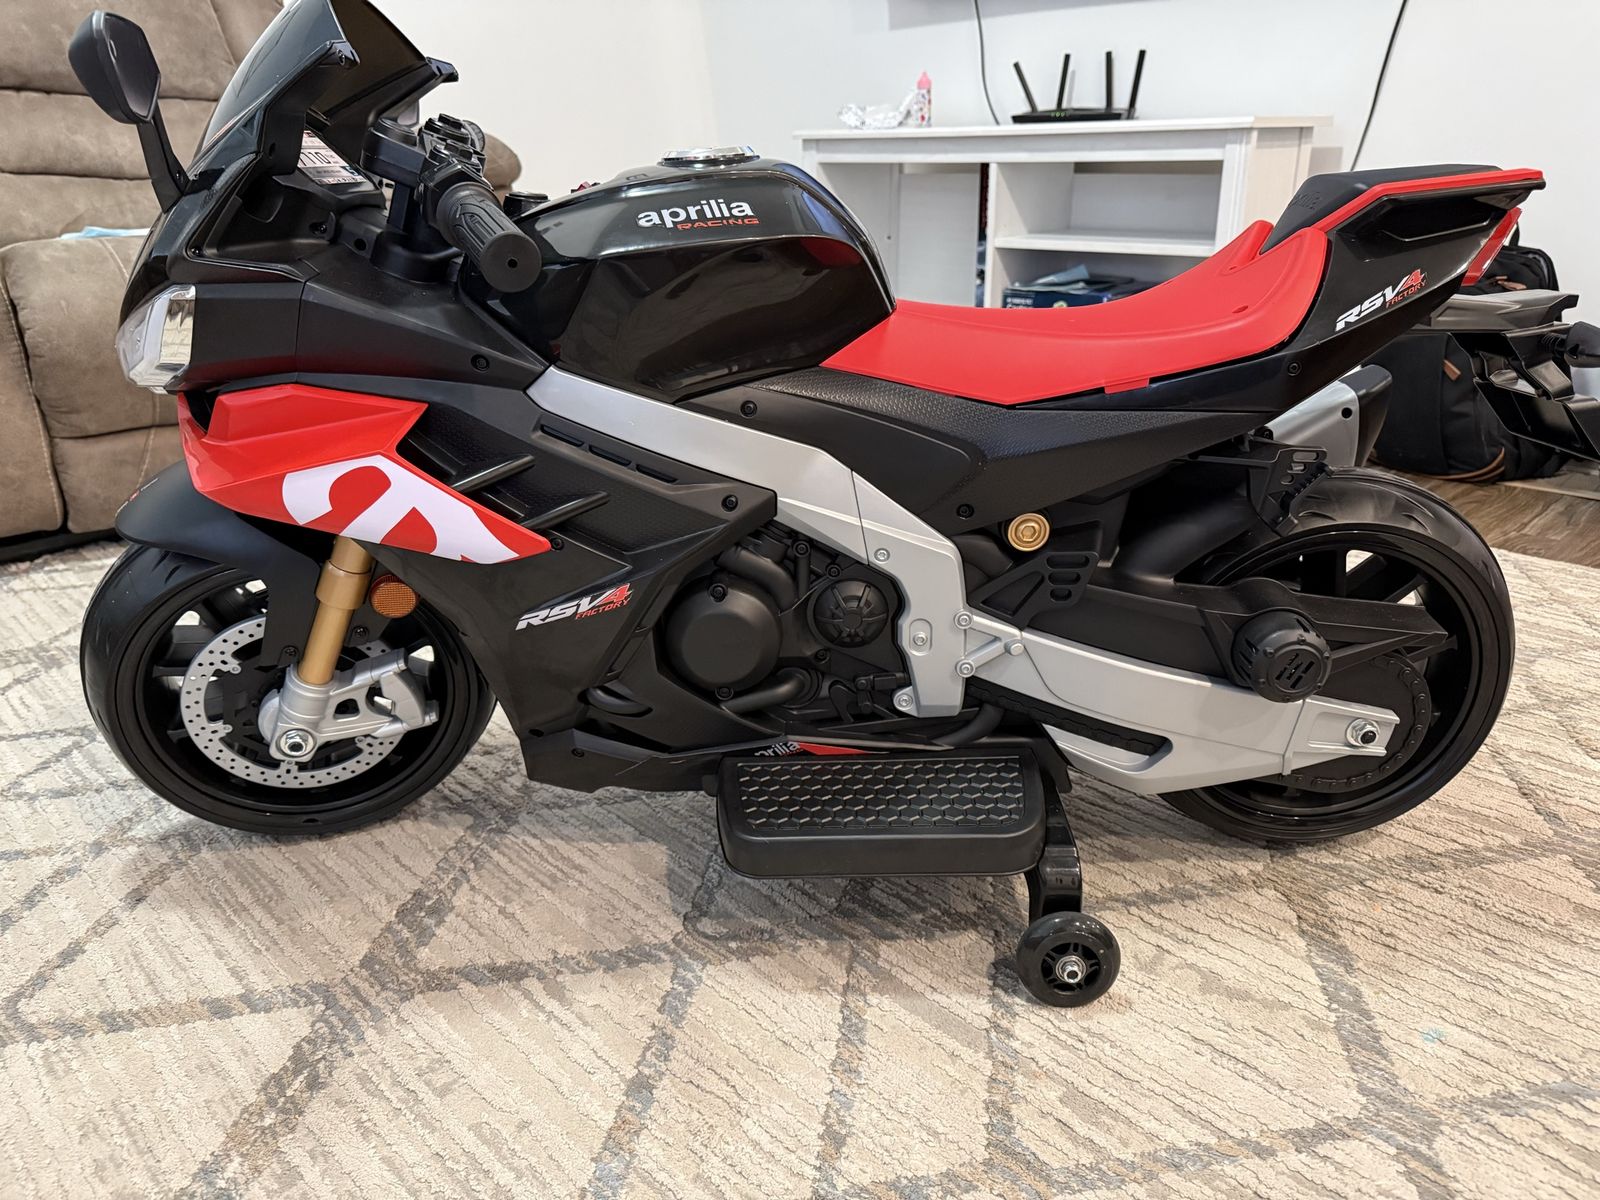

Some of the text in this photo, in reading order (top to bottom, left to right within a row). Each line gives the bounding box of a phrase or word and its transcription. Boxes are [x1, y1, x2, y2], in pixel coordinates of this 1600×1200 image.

[637, 199, 755, 229] aprilia
[676, 218, 760, 231] RACING
[1335, 269, 1425, 332] RSV4
[1386, 280, 1427, 308] FACTORY
[515, 583, 634, 630] RSV4
[575, 596, 632, 620] FACTORY
